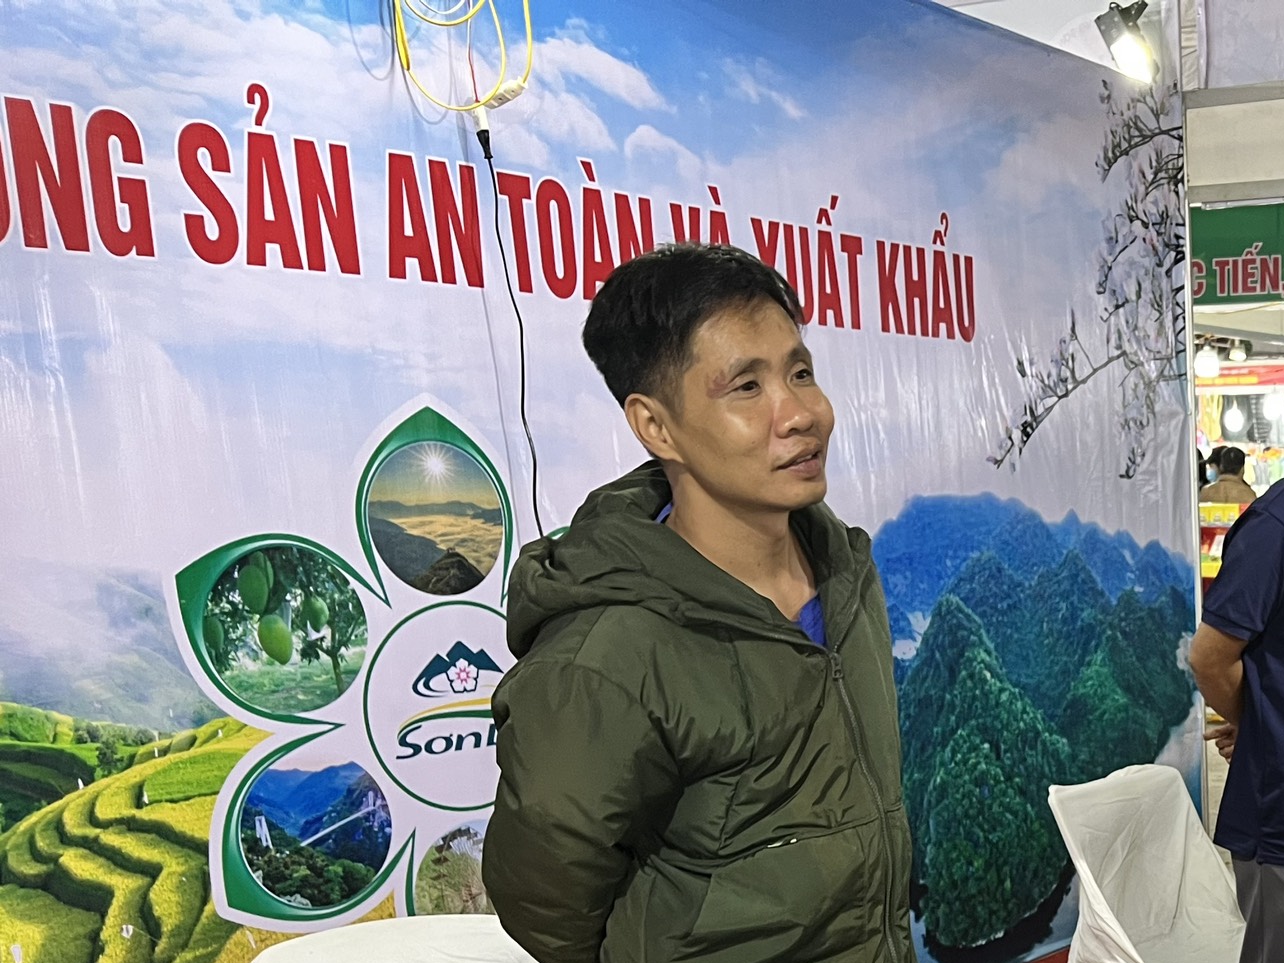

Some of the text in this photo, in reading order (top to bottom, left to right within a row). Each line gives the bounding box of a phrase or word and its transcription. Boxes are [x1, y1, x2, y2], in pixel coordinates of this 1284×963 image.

[176, 83, 361, 275] SẢN
[387, 153, 485, 288] AN
[877, 212, 976, 343] KHẨU
